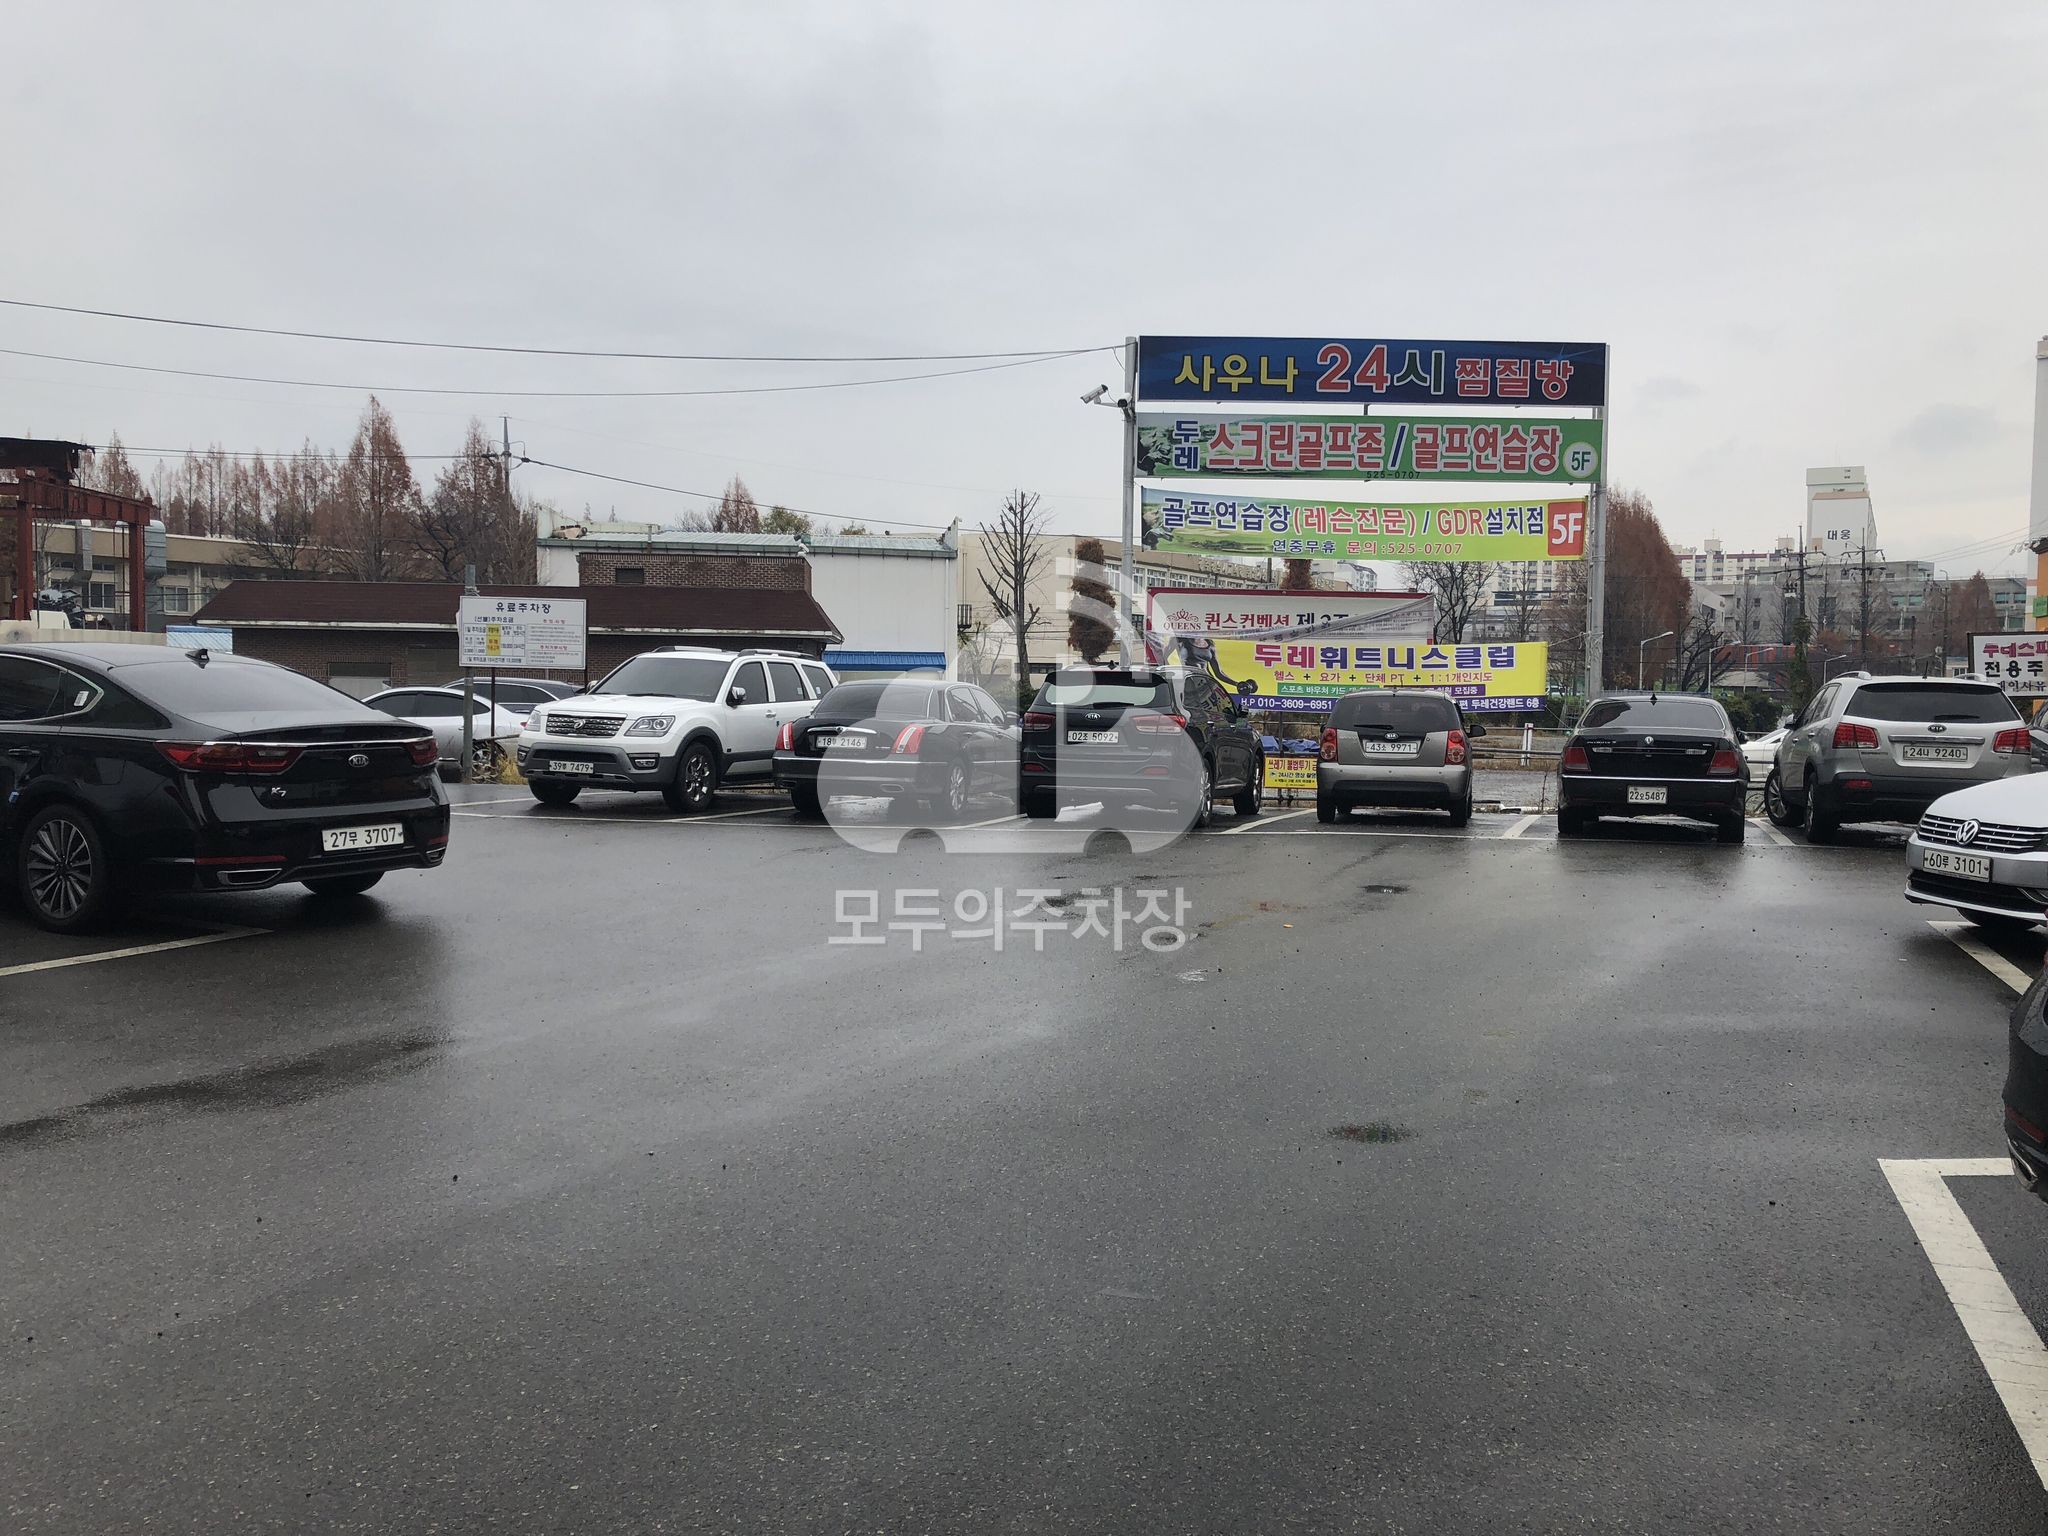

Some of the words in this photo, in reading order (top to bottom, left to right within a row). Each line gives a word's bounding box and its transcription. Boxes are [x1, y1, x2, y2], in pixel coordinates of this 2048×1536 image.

[1174, 354, 1299, 393] 사우나
[1316, 343, 1445, 395] 24시
[1455, 358, 1574, 401] 찜질방
[1174, 420, 1200, 470] 두레
[1571, 450, 1592, 472] 5F
[1366, 470, 1421, 480] 525-0707
[1552, 512, 1584, 545] 5F
[1827, 529, 1851, 541] 대웅
[1272, 538, 1337, 554] 연중무휴
[496, 602, 551, 614] 유료주차장
[1163, 621, 1201, 631] QUEENS
[1274, 670, 1295, 681] 헬스
[1319, 672, 1341, 682] 요가
[1365, 672, 1386, 683] 단체
[1391, 673, 1405, 683] PT
[1454, 686, 1478, 695] 모집중
[1257, 698, 1333, 710] 010-3609-6951
[1092, 732, 1114, 741] 5092
[1390, 743, 1413, 752] 9971
[1936, 748, 1962, 758] 9240
[352, 756, 368, 765] KIA
[570, 763, 590, 773] 7479
[270, 787, 287, 797] K7
[330, 831, 358, 848] 27무
[364, 827, 397, 845] 3707
[1928, 852, 1949, 868] 60루
[1953, 856, 1982, 875] 3101
